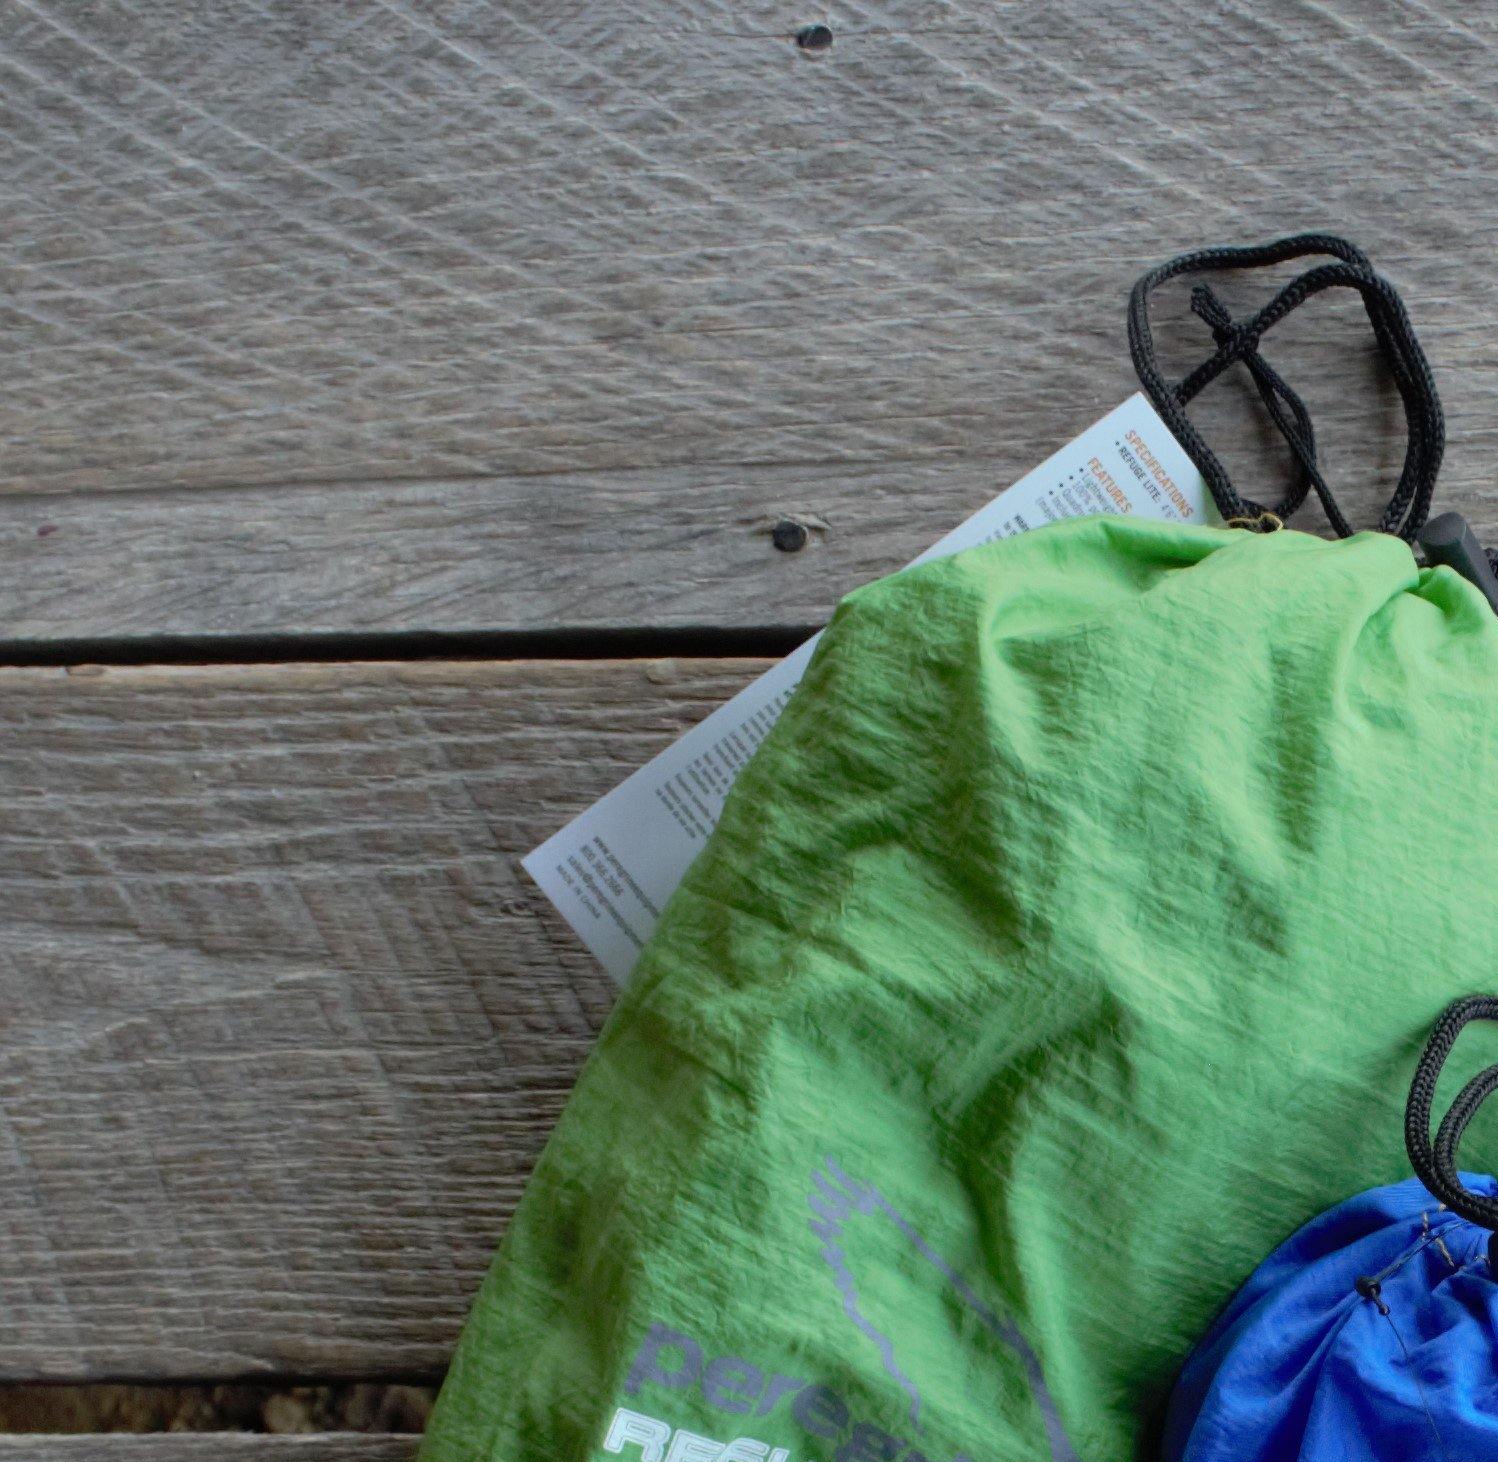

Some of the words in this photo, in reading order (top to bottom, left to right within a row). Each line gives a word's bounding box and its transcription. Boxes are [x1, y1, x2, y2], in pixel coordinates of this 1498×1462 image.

[1085, 456, 1134, 514] FEATURES
[1116, 445, 1146, 481] REFUGE
[1122, 428, 1196, 519] SPECIFICATIONS
